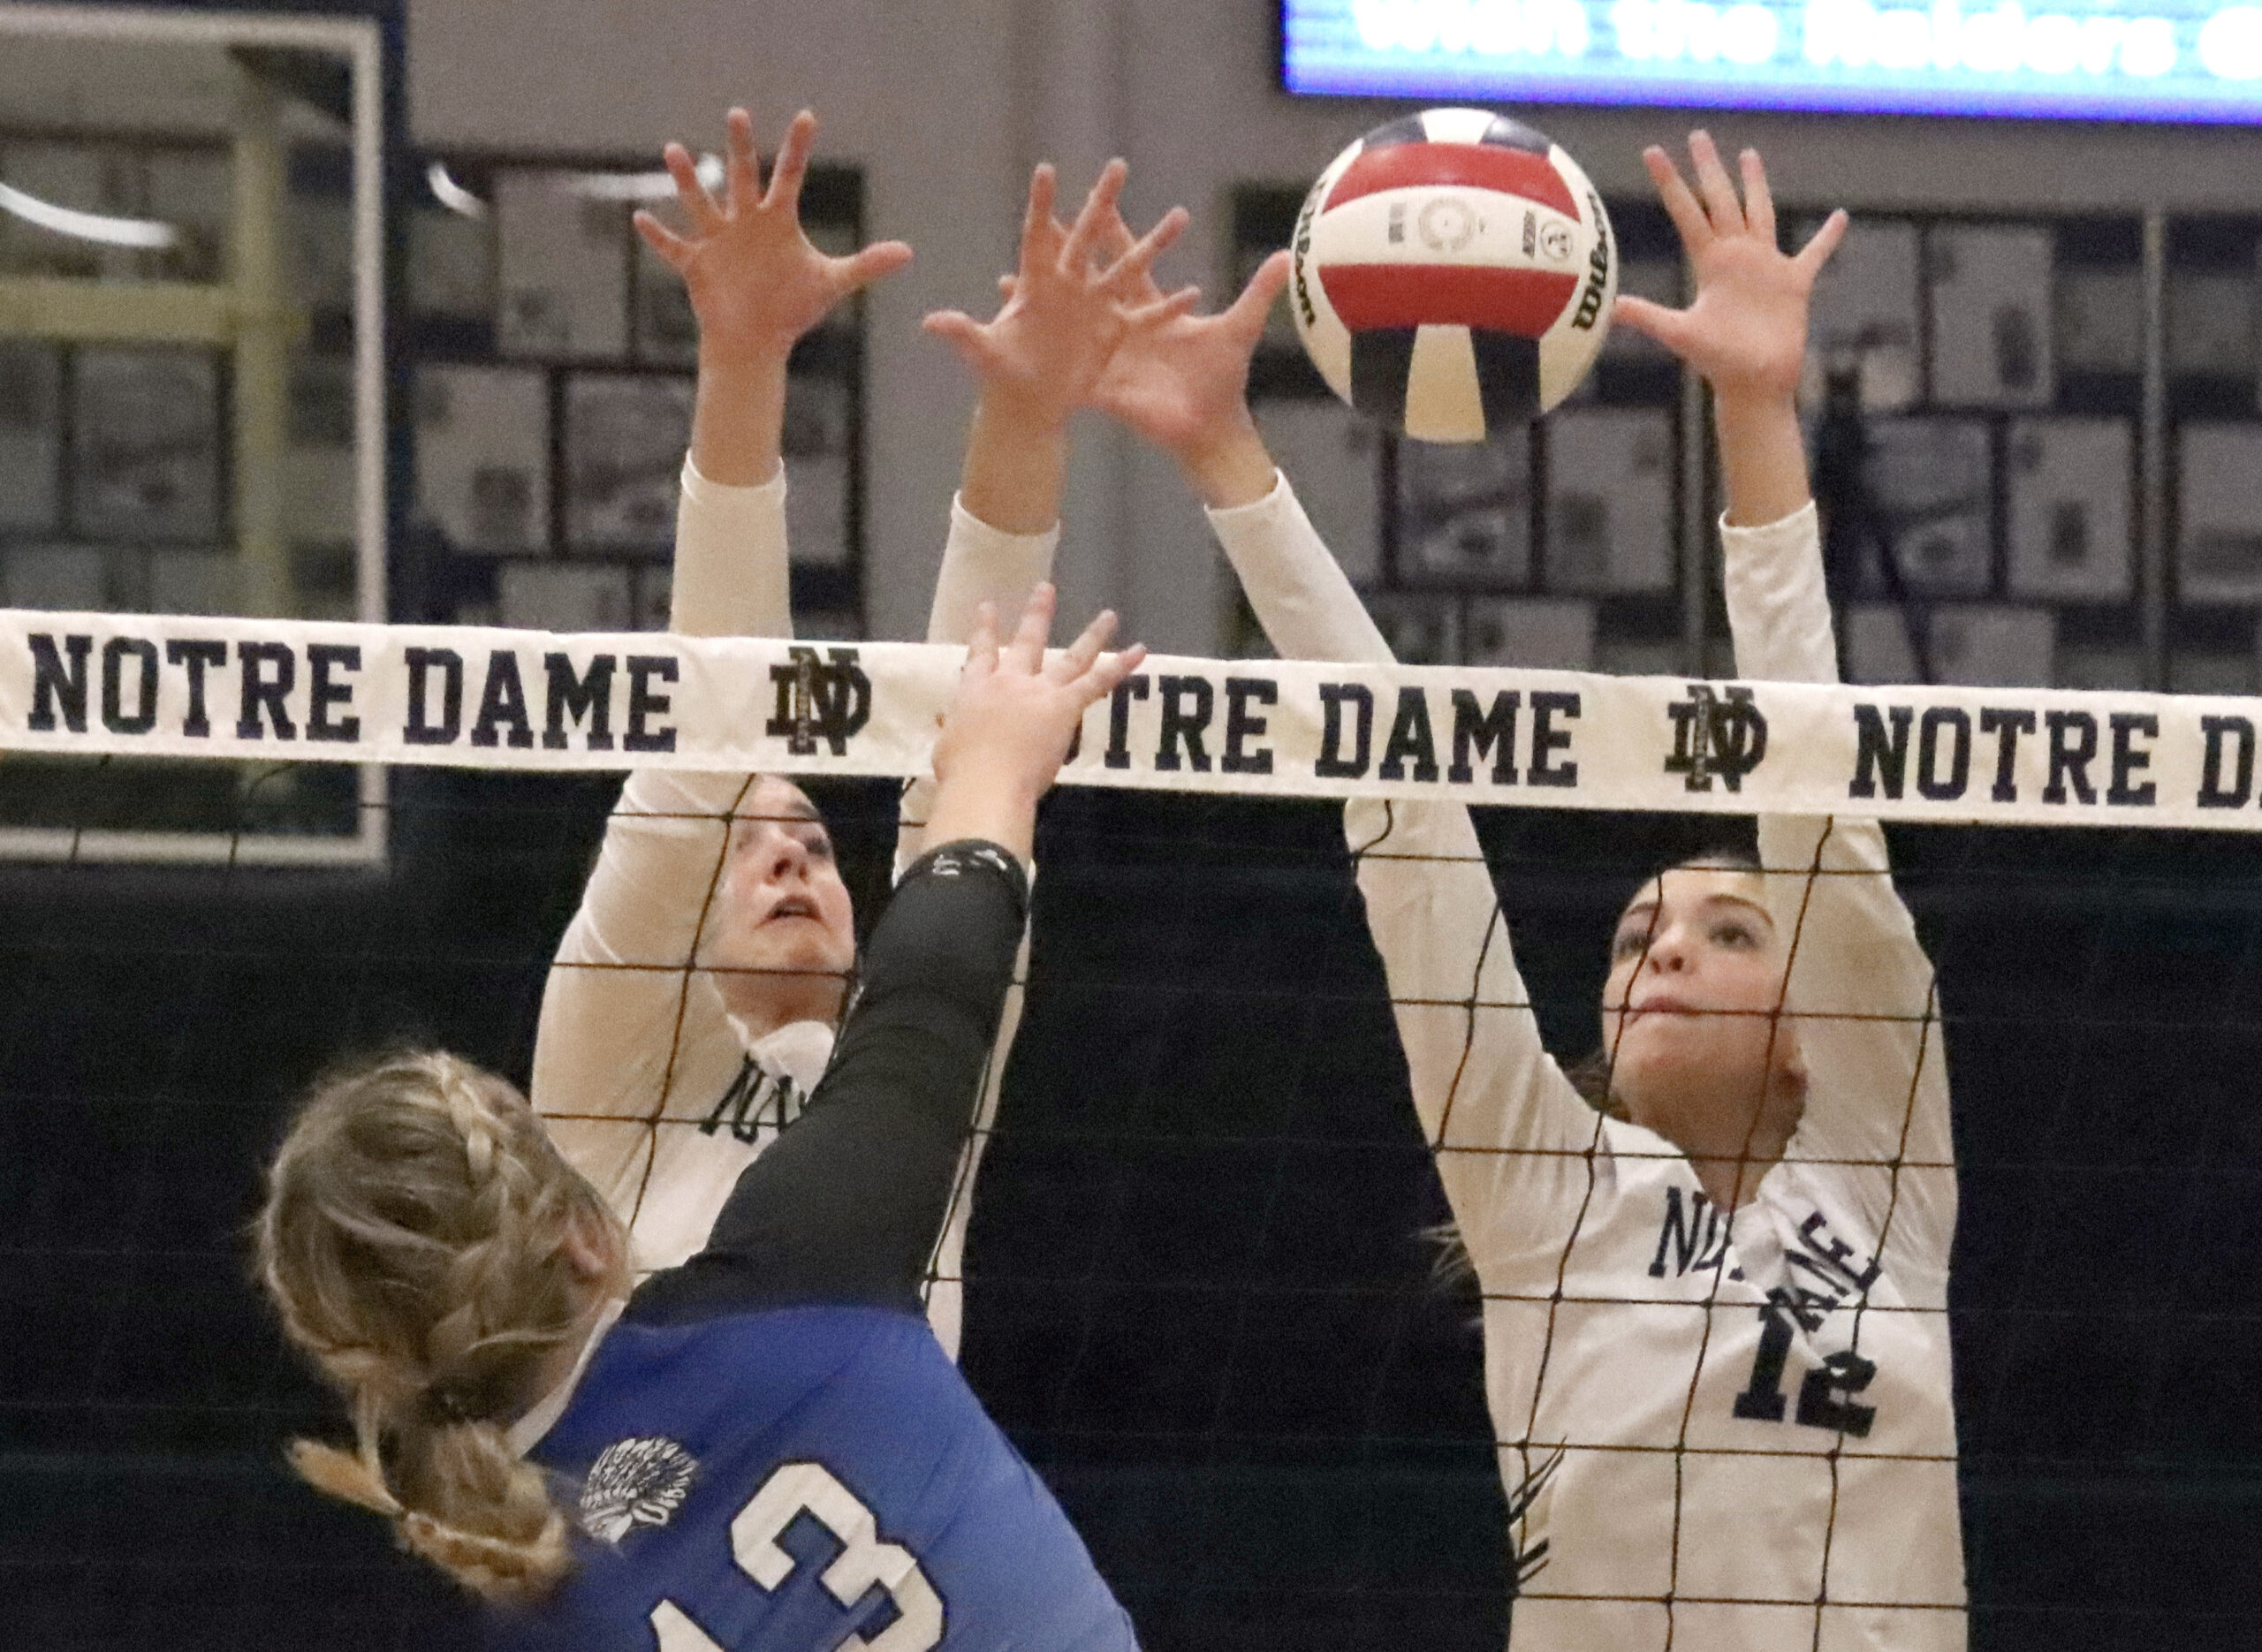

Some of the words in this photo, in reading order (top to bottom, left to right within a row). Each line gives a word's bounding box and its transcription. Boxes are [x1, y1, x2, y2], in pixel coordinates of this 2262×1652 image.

[1611, 0, 1777, 63] the
[1804, 0, 2177, 77] Raiders
[27, 633, 362, 743] NOTRE
[403, 647, 680, 753] DAME
[1062, 675, 1279, 774] TRE
[1314, 682, 1583, 787] DAME
[1849, 704, 2159, 806] NOTRE
[2197, 715, 2262, 810] D
[1732, 1303, 1879, 1439] 12
